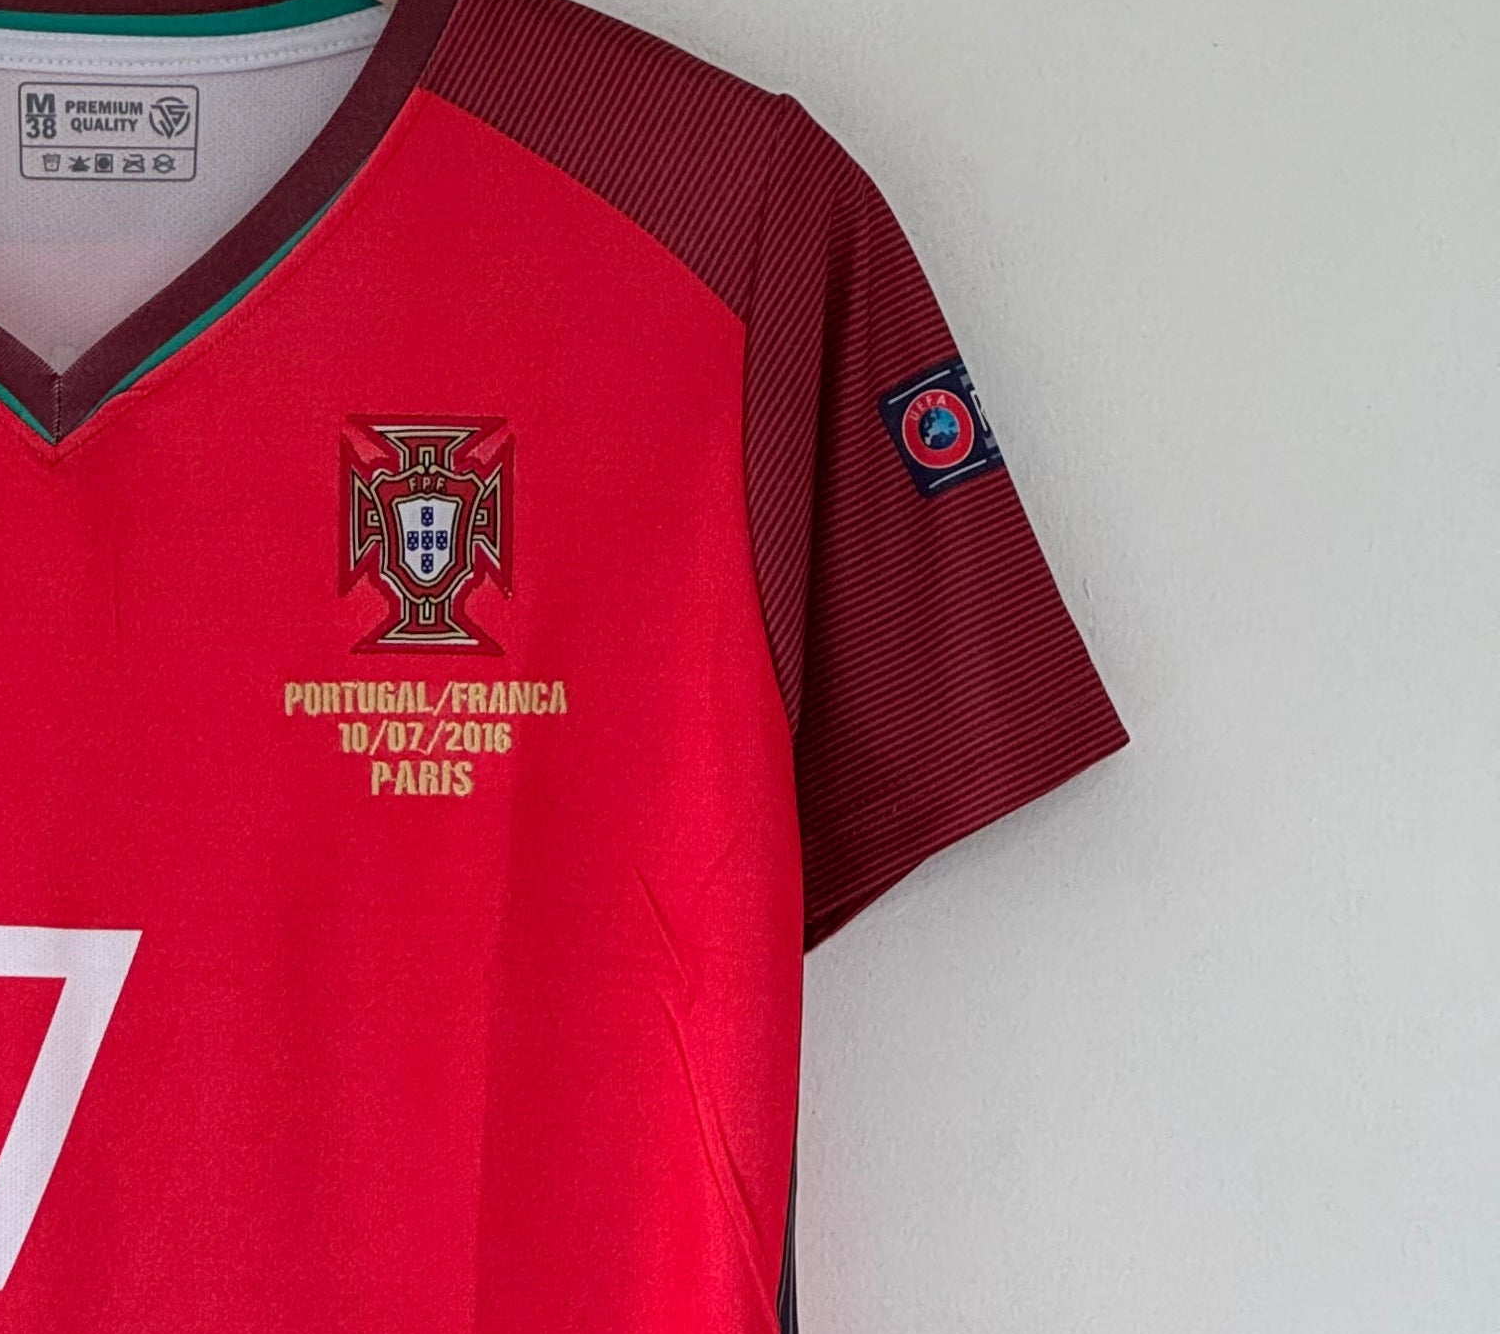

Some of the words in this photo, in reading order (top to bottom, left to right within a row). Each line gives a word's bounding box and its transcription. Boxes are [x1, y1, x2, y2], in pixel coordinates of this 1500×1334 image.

[26, 92, 56, 113] M
[65, 100, 143, 115] PREMIUM
[26, 118, 57, 139] 38
[70, 119, 138, 134] QUALITY
[908, 394, 947, 422] UEFA
[338, 719, 512, 756] 10/07/2016
[370, 760, 475, 797] PARIS
